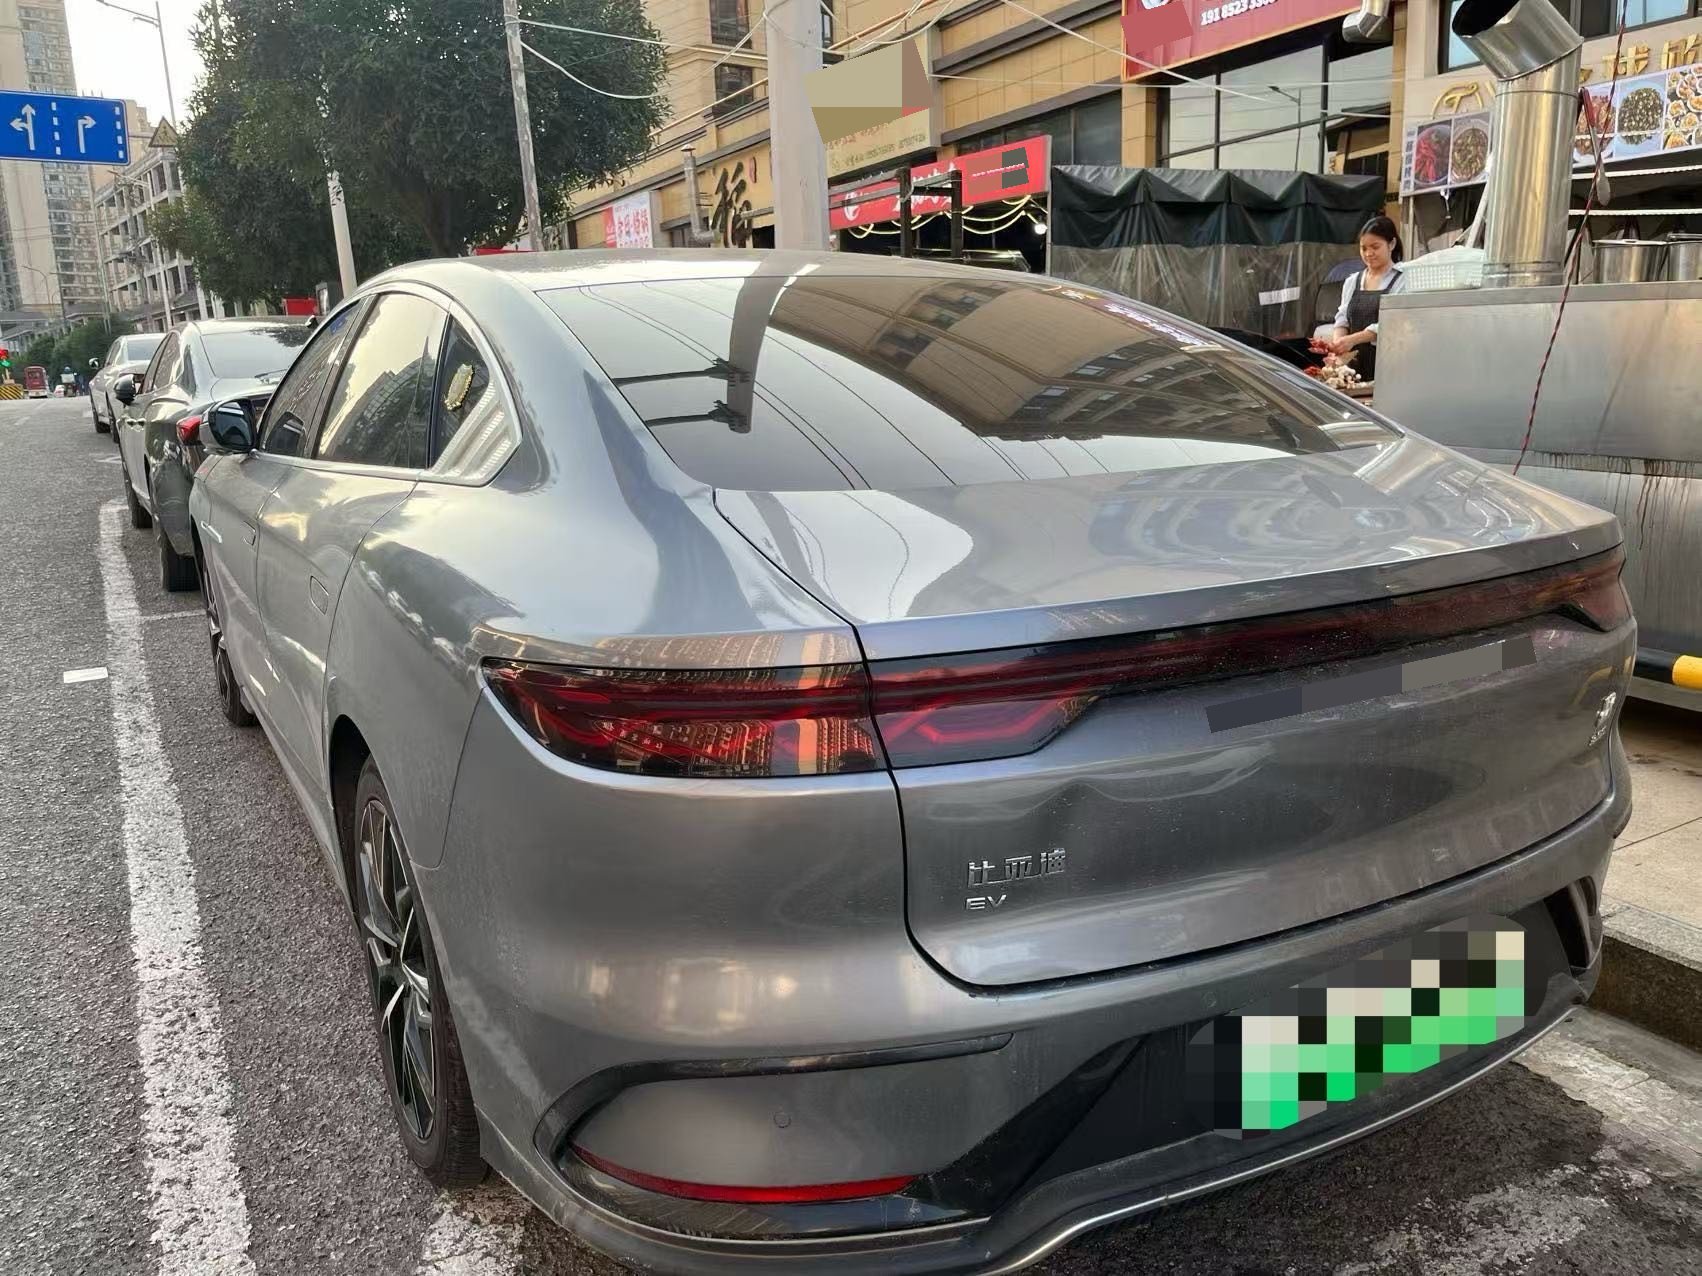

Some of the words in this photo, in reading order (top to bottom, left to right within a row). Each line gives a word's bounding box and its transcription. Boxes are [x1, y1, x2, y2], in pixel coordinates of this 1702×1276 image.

[1201, 7, 1220, 25] 191
[967, 848, 1066, 887] 比亚迪
[965, 895, 1007, 910] EV
